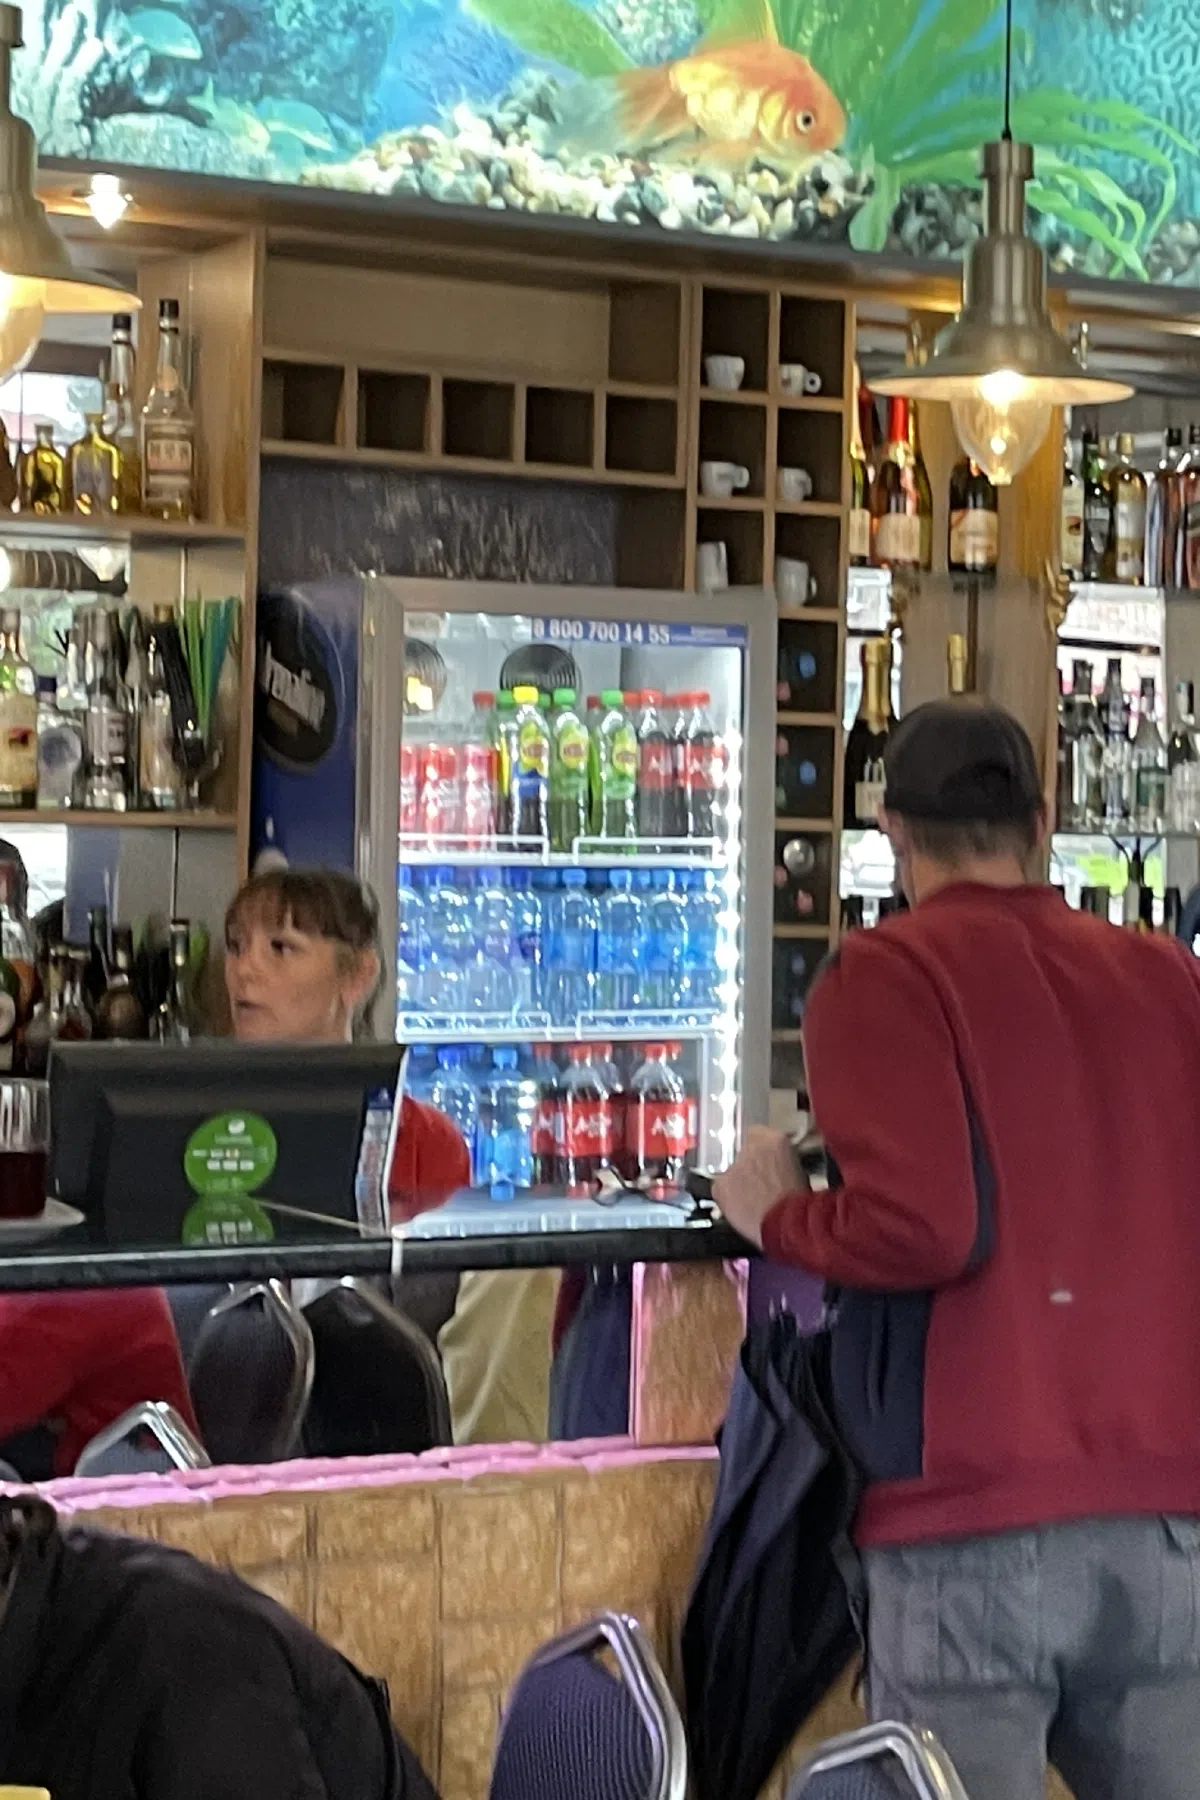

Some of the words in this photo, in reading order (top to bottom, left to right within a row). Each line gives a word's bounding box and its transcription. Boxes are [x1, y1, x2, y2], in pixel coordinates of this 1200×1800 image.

[550, 619, 583, 640] 800
[588, 621, 619, 642] 700
[624, 623, 643, 643] 14
